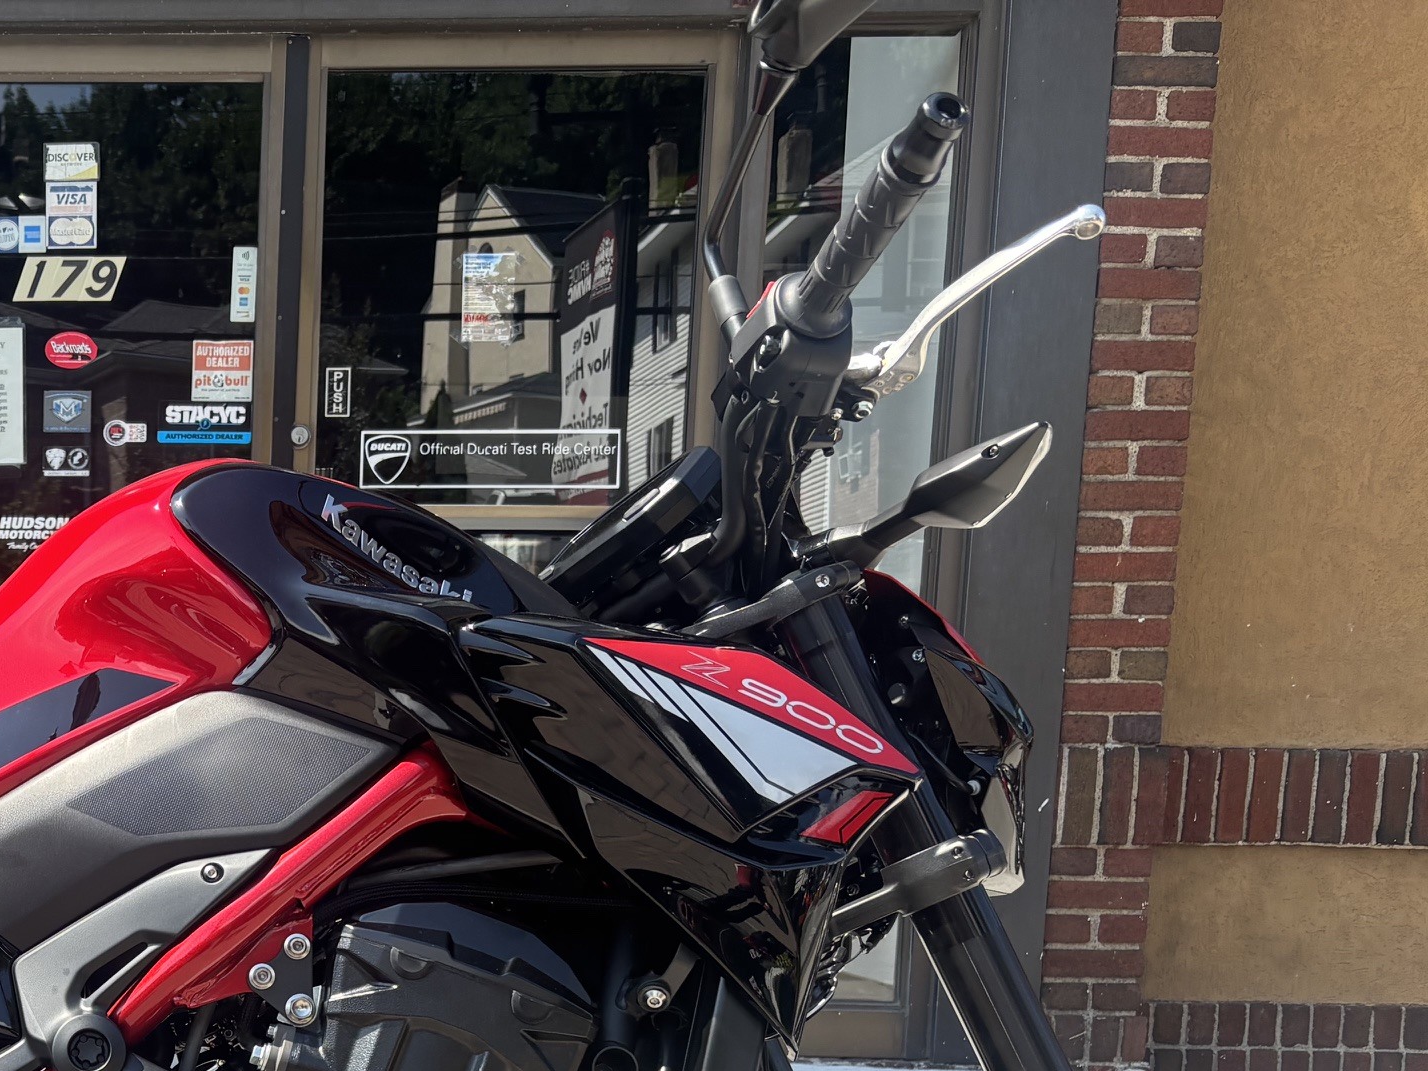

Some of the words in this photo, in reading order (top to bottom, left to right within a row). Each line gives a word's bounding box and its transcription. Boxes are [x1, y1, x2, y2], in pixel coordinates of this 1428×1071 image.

[47, 153, 96, 162] DISCOVER
[56, 193, 87, 205] VISA
[26, 259, 118, 299] 179
[50, 341, 92, 354] Backroads
[196, 345, 250, 357] AUTHORIZED
[205, 357, 240, 368] DEALER
[194, 374, 212, 389] pit
[224, 375, 250, 387] bull
[332, 371, 344, 414] PUSH
[165, 404, 247, 425] STACYC
[370, 442, 407, 451] DUCATI
[419, 442, 464, 455] Official
[466, 442, 507, 455] Ducati
[510, 442, 538, 455] Test
[541, 442, 570, 455] Ride
[573, 442, 618, 455] Center
[320, 493, 473, 603] Kawasaki
